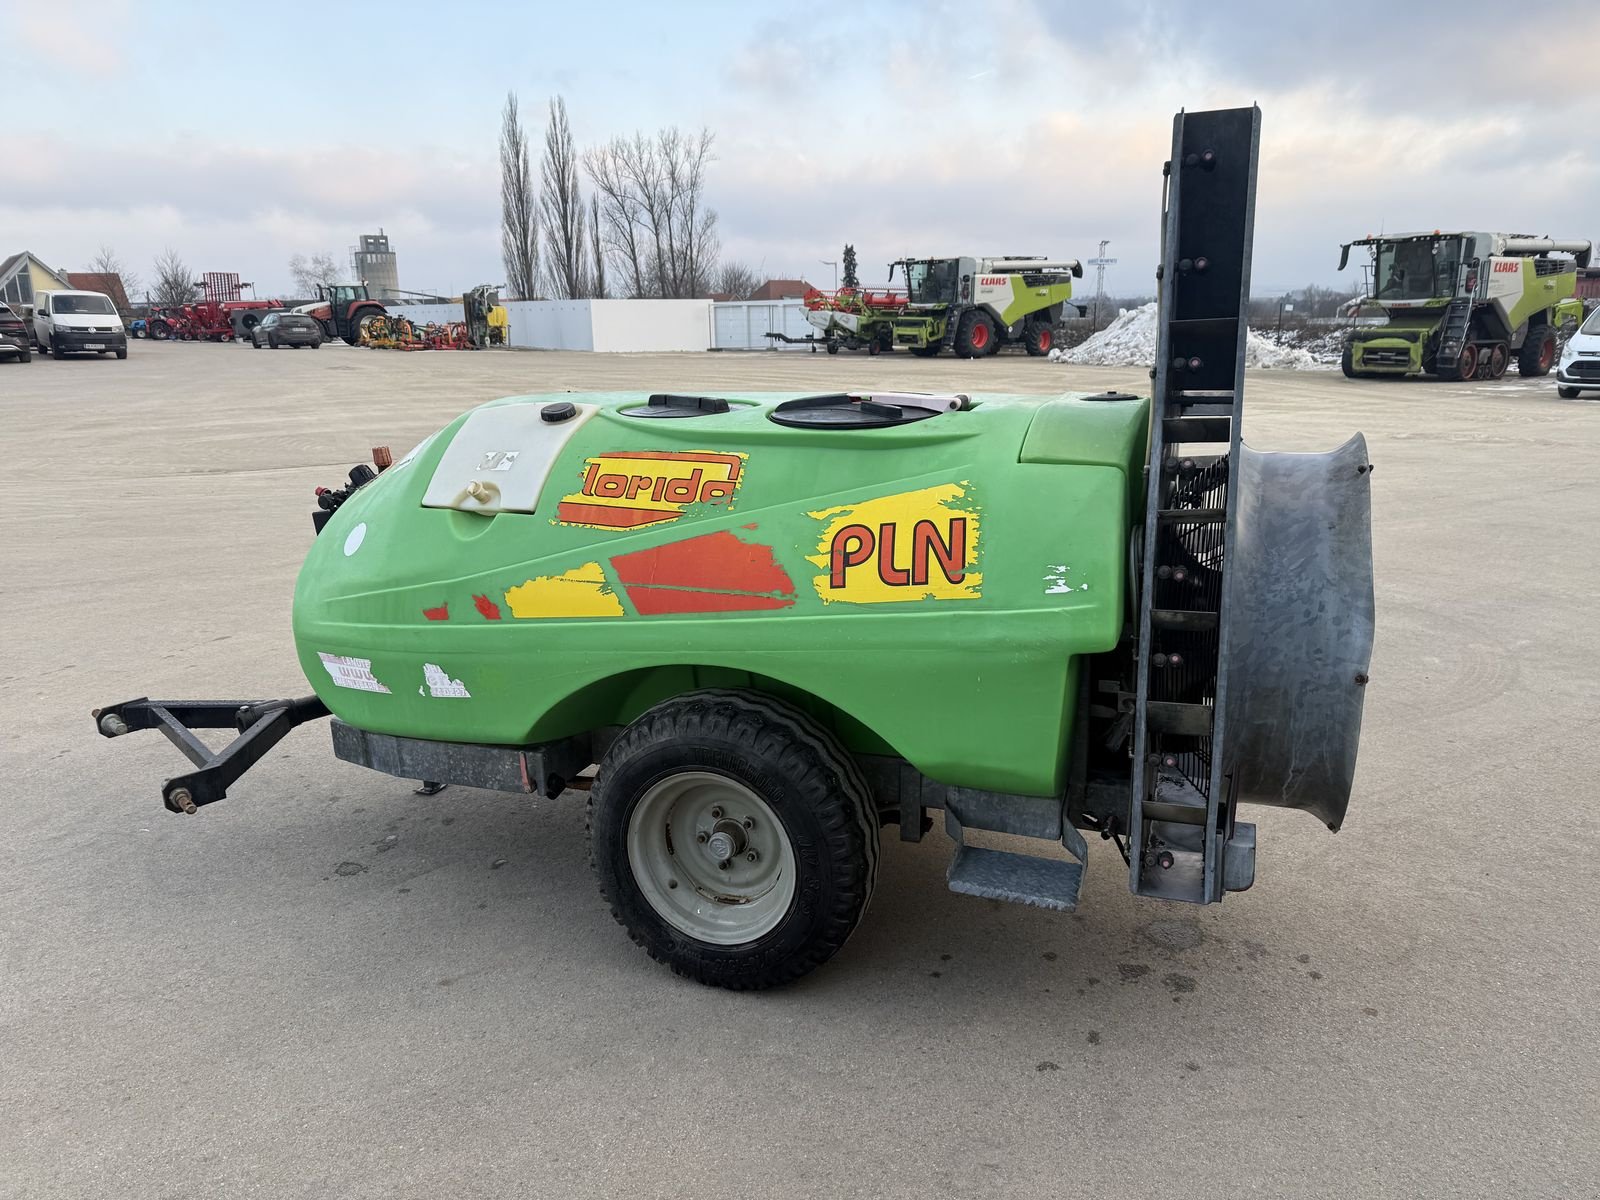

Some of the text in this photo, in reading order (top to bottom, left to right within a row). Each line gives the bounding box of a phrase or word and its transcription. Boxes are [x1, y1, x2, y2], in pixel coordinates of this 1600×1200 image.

[1494, 262, 1519, 273] CLAAS
[980, 277, 1007, 286] CLAAS
[830, 517, 966, 589] PLN
